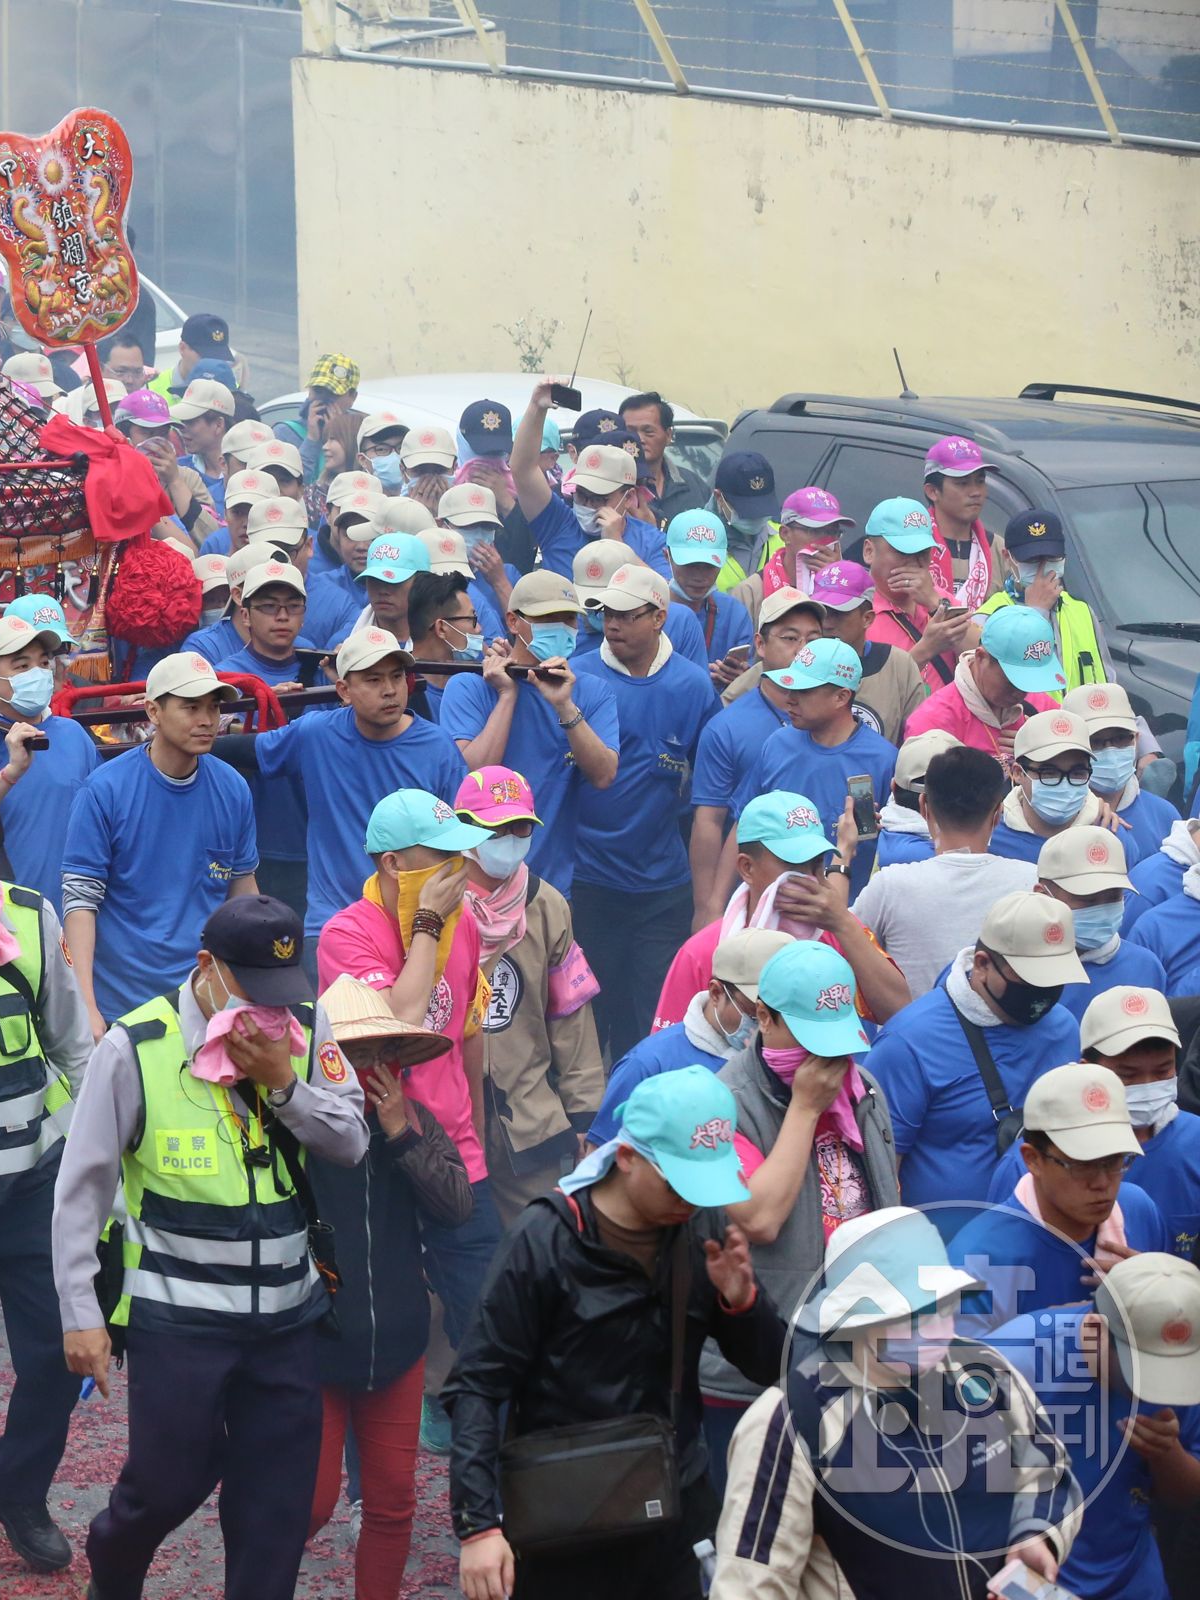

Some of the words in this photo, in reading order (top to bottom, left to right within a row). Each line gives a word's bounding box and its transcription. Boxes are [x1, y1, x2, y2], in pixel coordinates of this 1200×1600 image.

[80, 133, 104, 160] 大
[52, 197, 94, 303] 鎮瀾宮
[167, 1136, 205, 1151] 警察
[162, 1156, 212, 1169] POLICE
